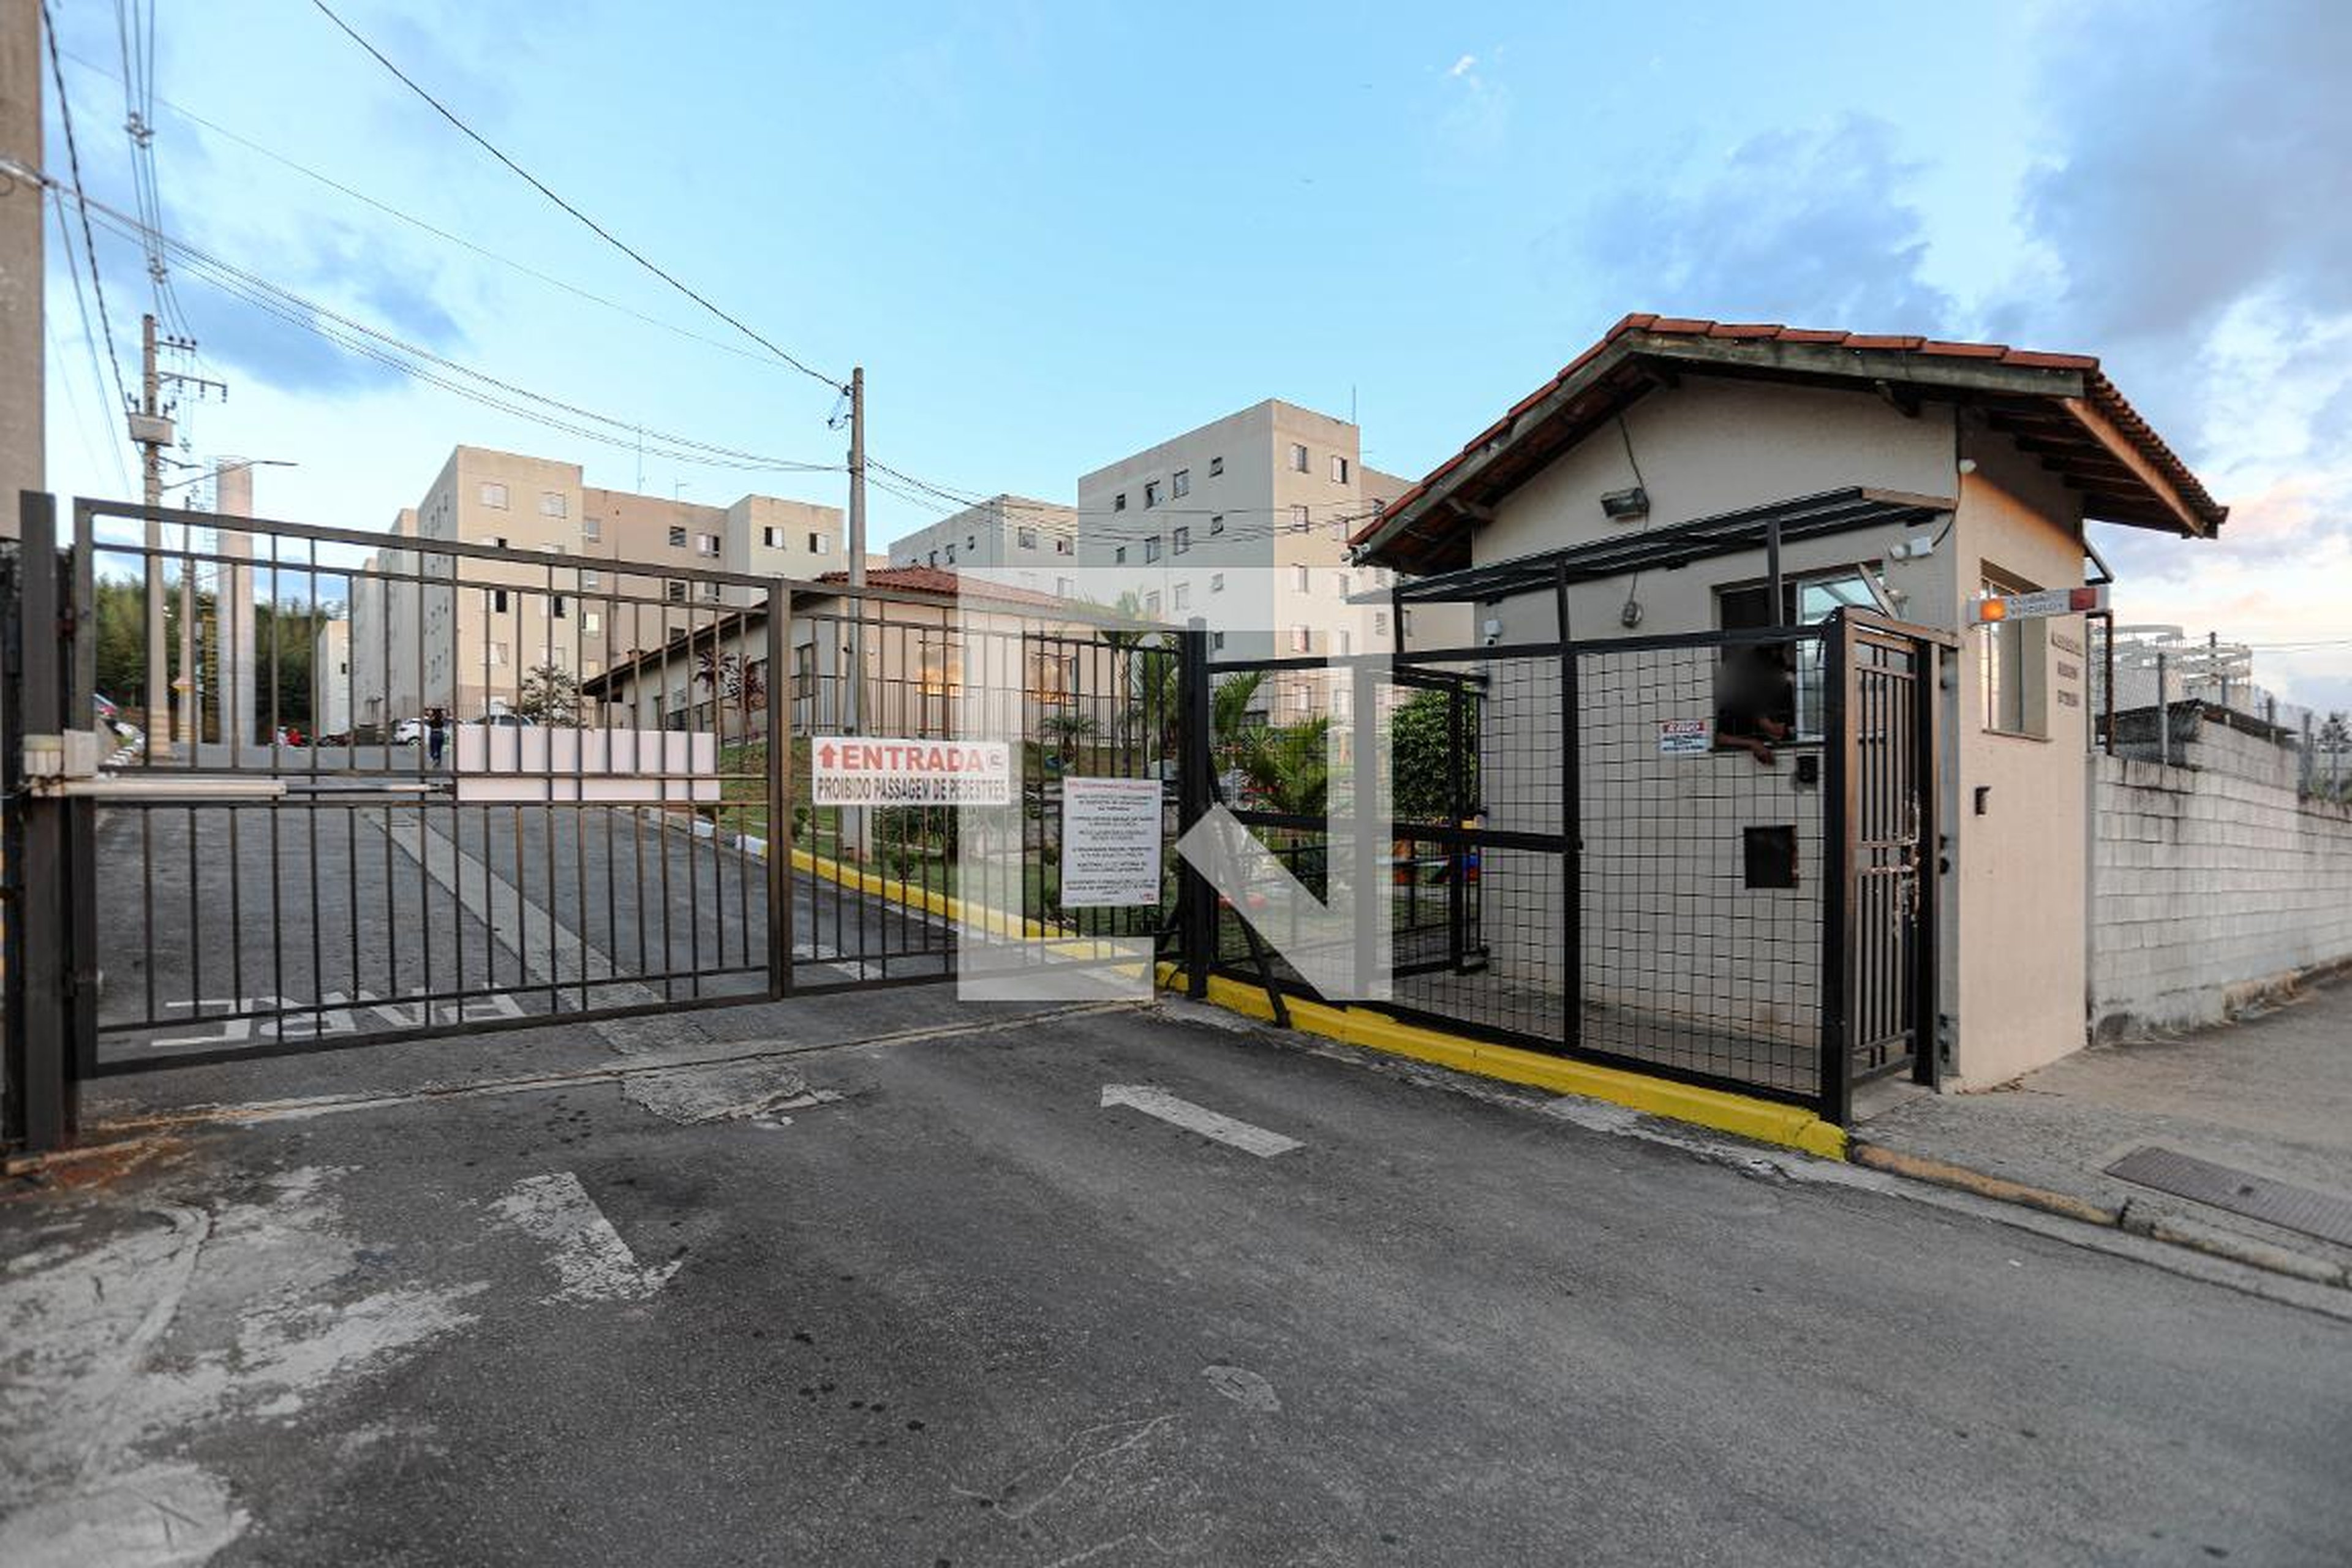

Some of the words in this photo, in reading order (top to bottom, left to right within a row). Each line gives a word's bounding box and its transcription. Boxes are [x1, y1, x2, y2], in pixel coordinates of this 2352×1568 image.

[842, 745, 984, 772] ENTRADA
[818, 777, 870, 799] PROIBIDO
[933, 777, 947, 800] DE
